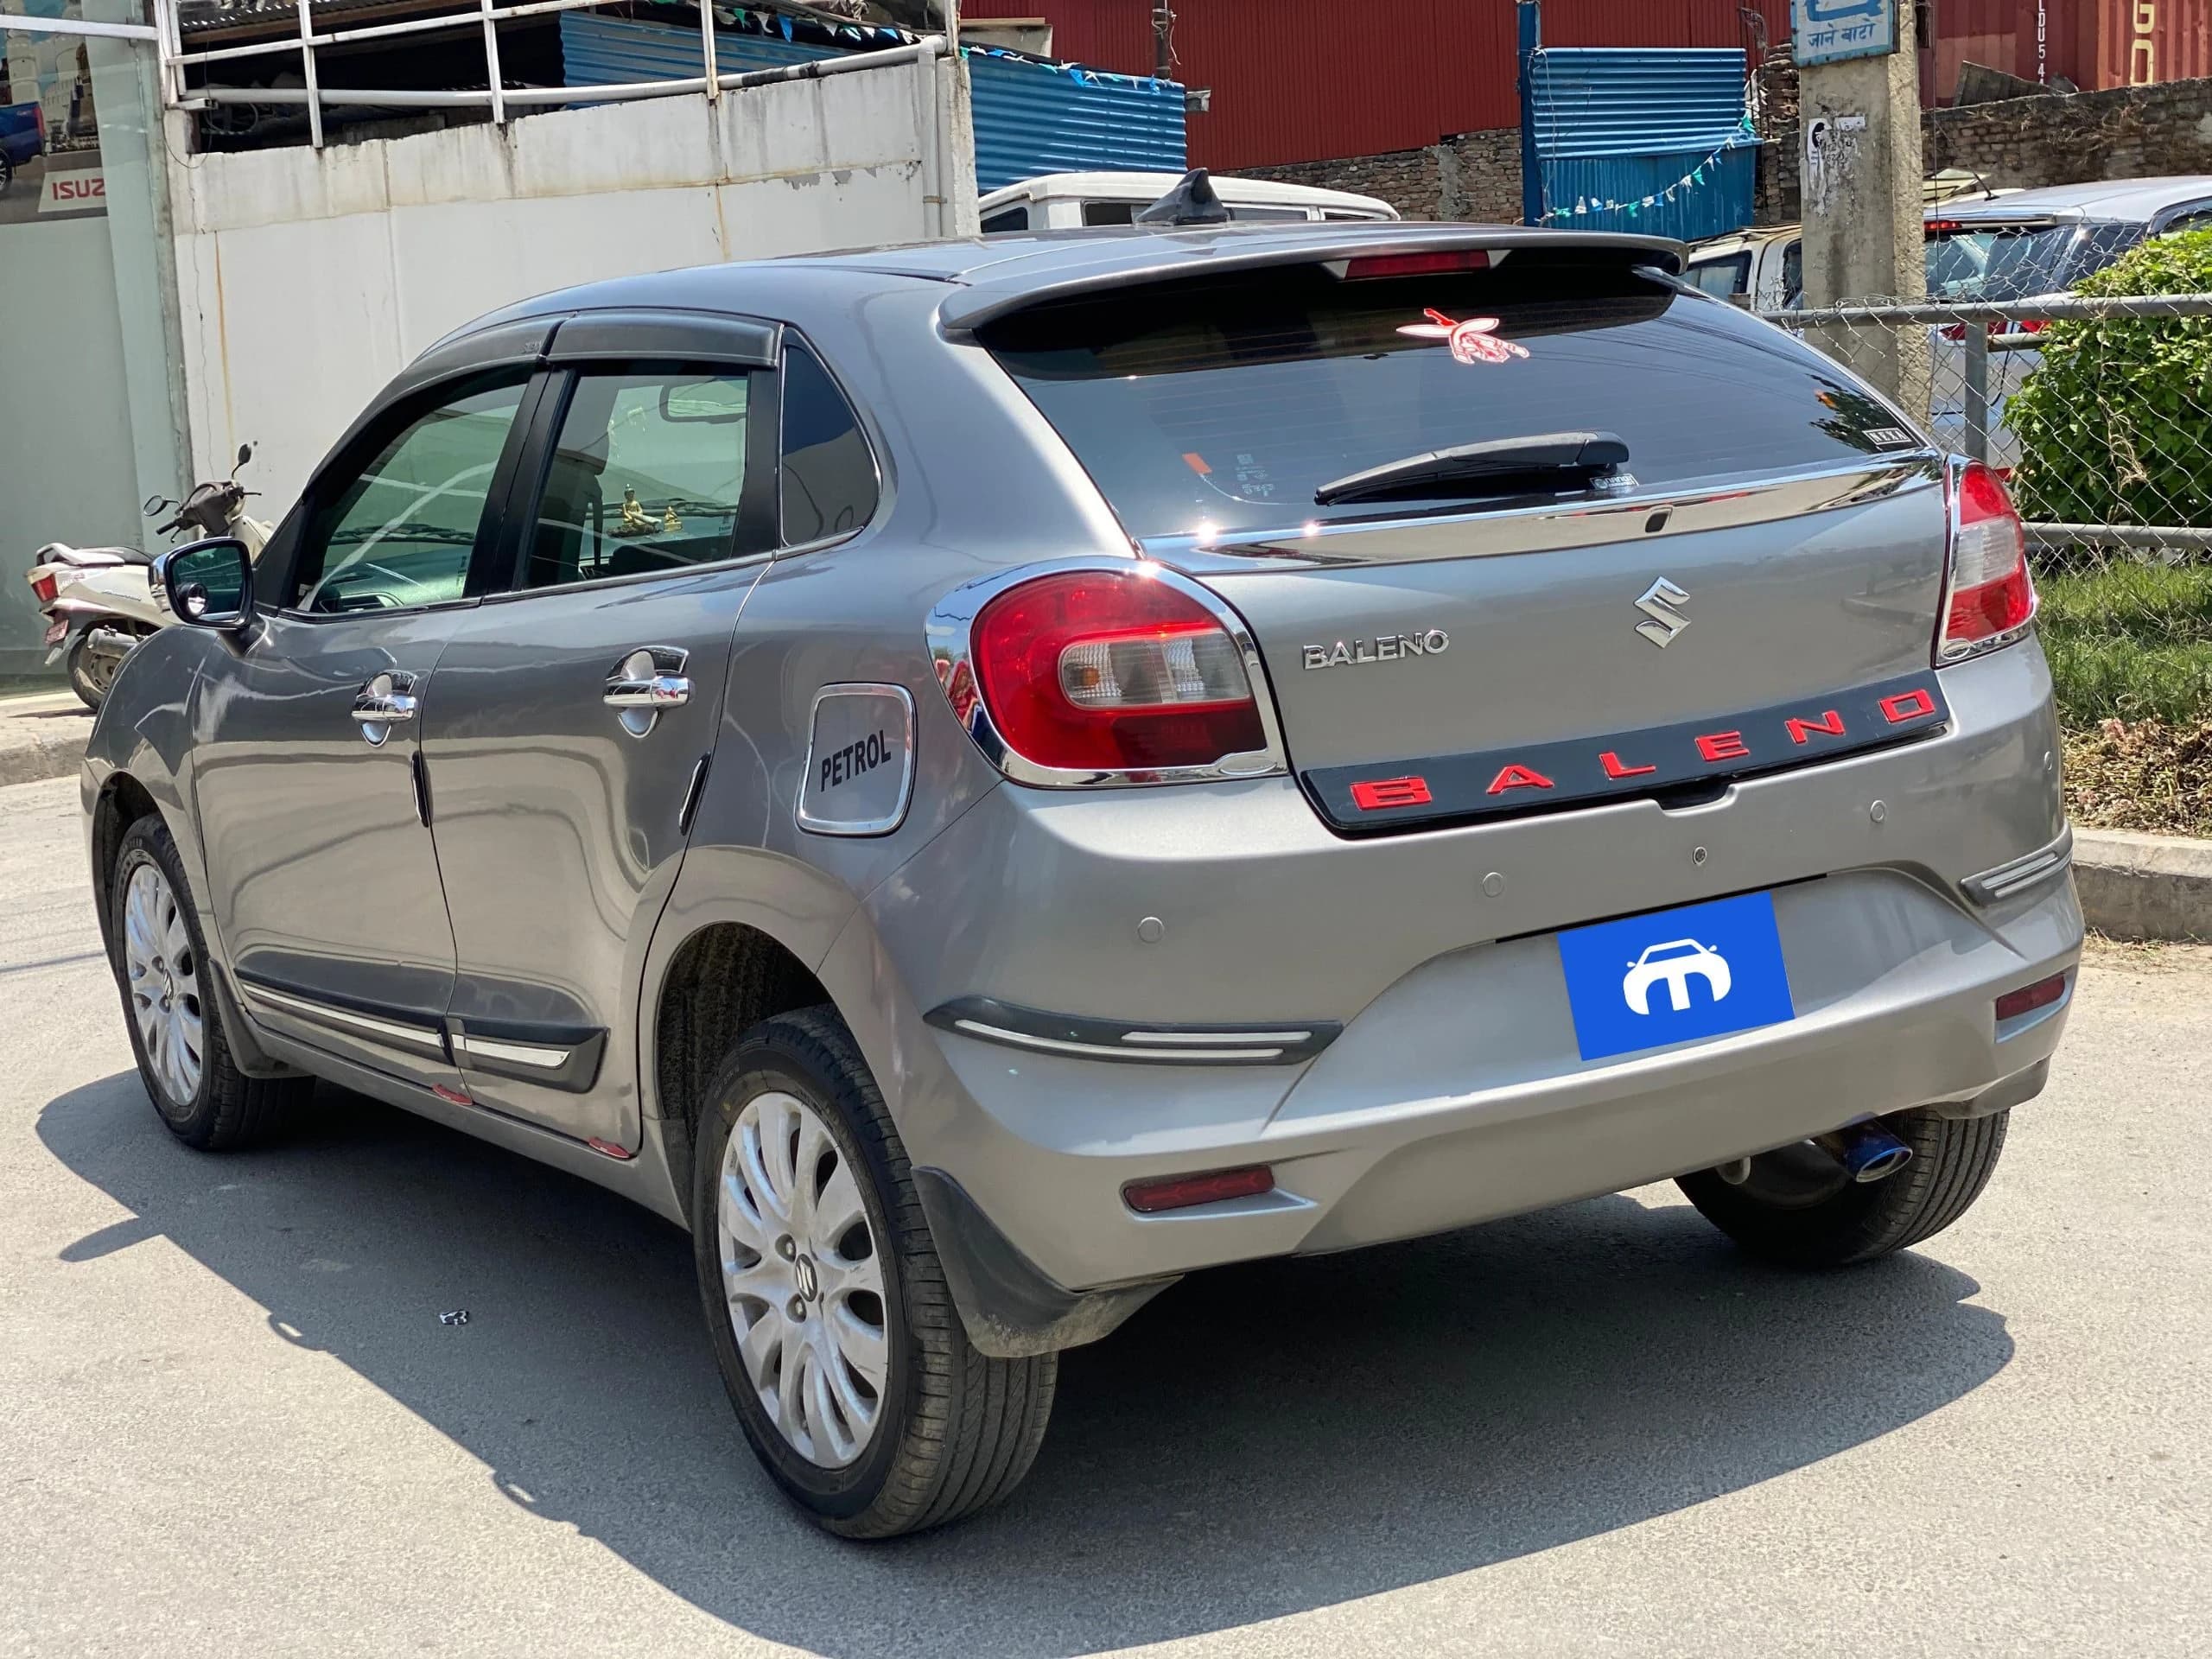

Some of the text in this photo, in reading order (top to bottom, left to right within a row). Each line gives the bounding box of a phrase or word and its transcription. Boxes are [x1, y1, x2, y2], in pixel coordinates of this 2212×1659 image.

[1807, 22, 1838, 48] जाने
[1866, 429, 1909, 442] NEXA
[1302, 629, 1450, 671] BALENO
[821, 729, 892, 792] PETROL
[1350, 689, 1936, 811] BALENO
